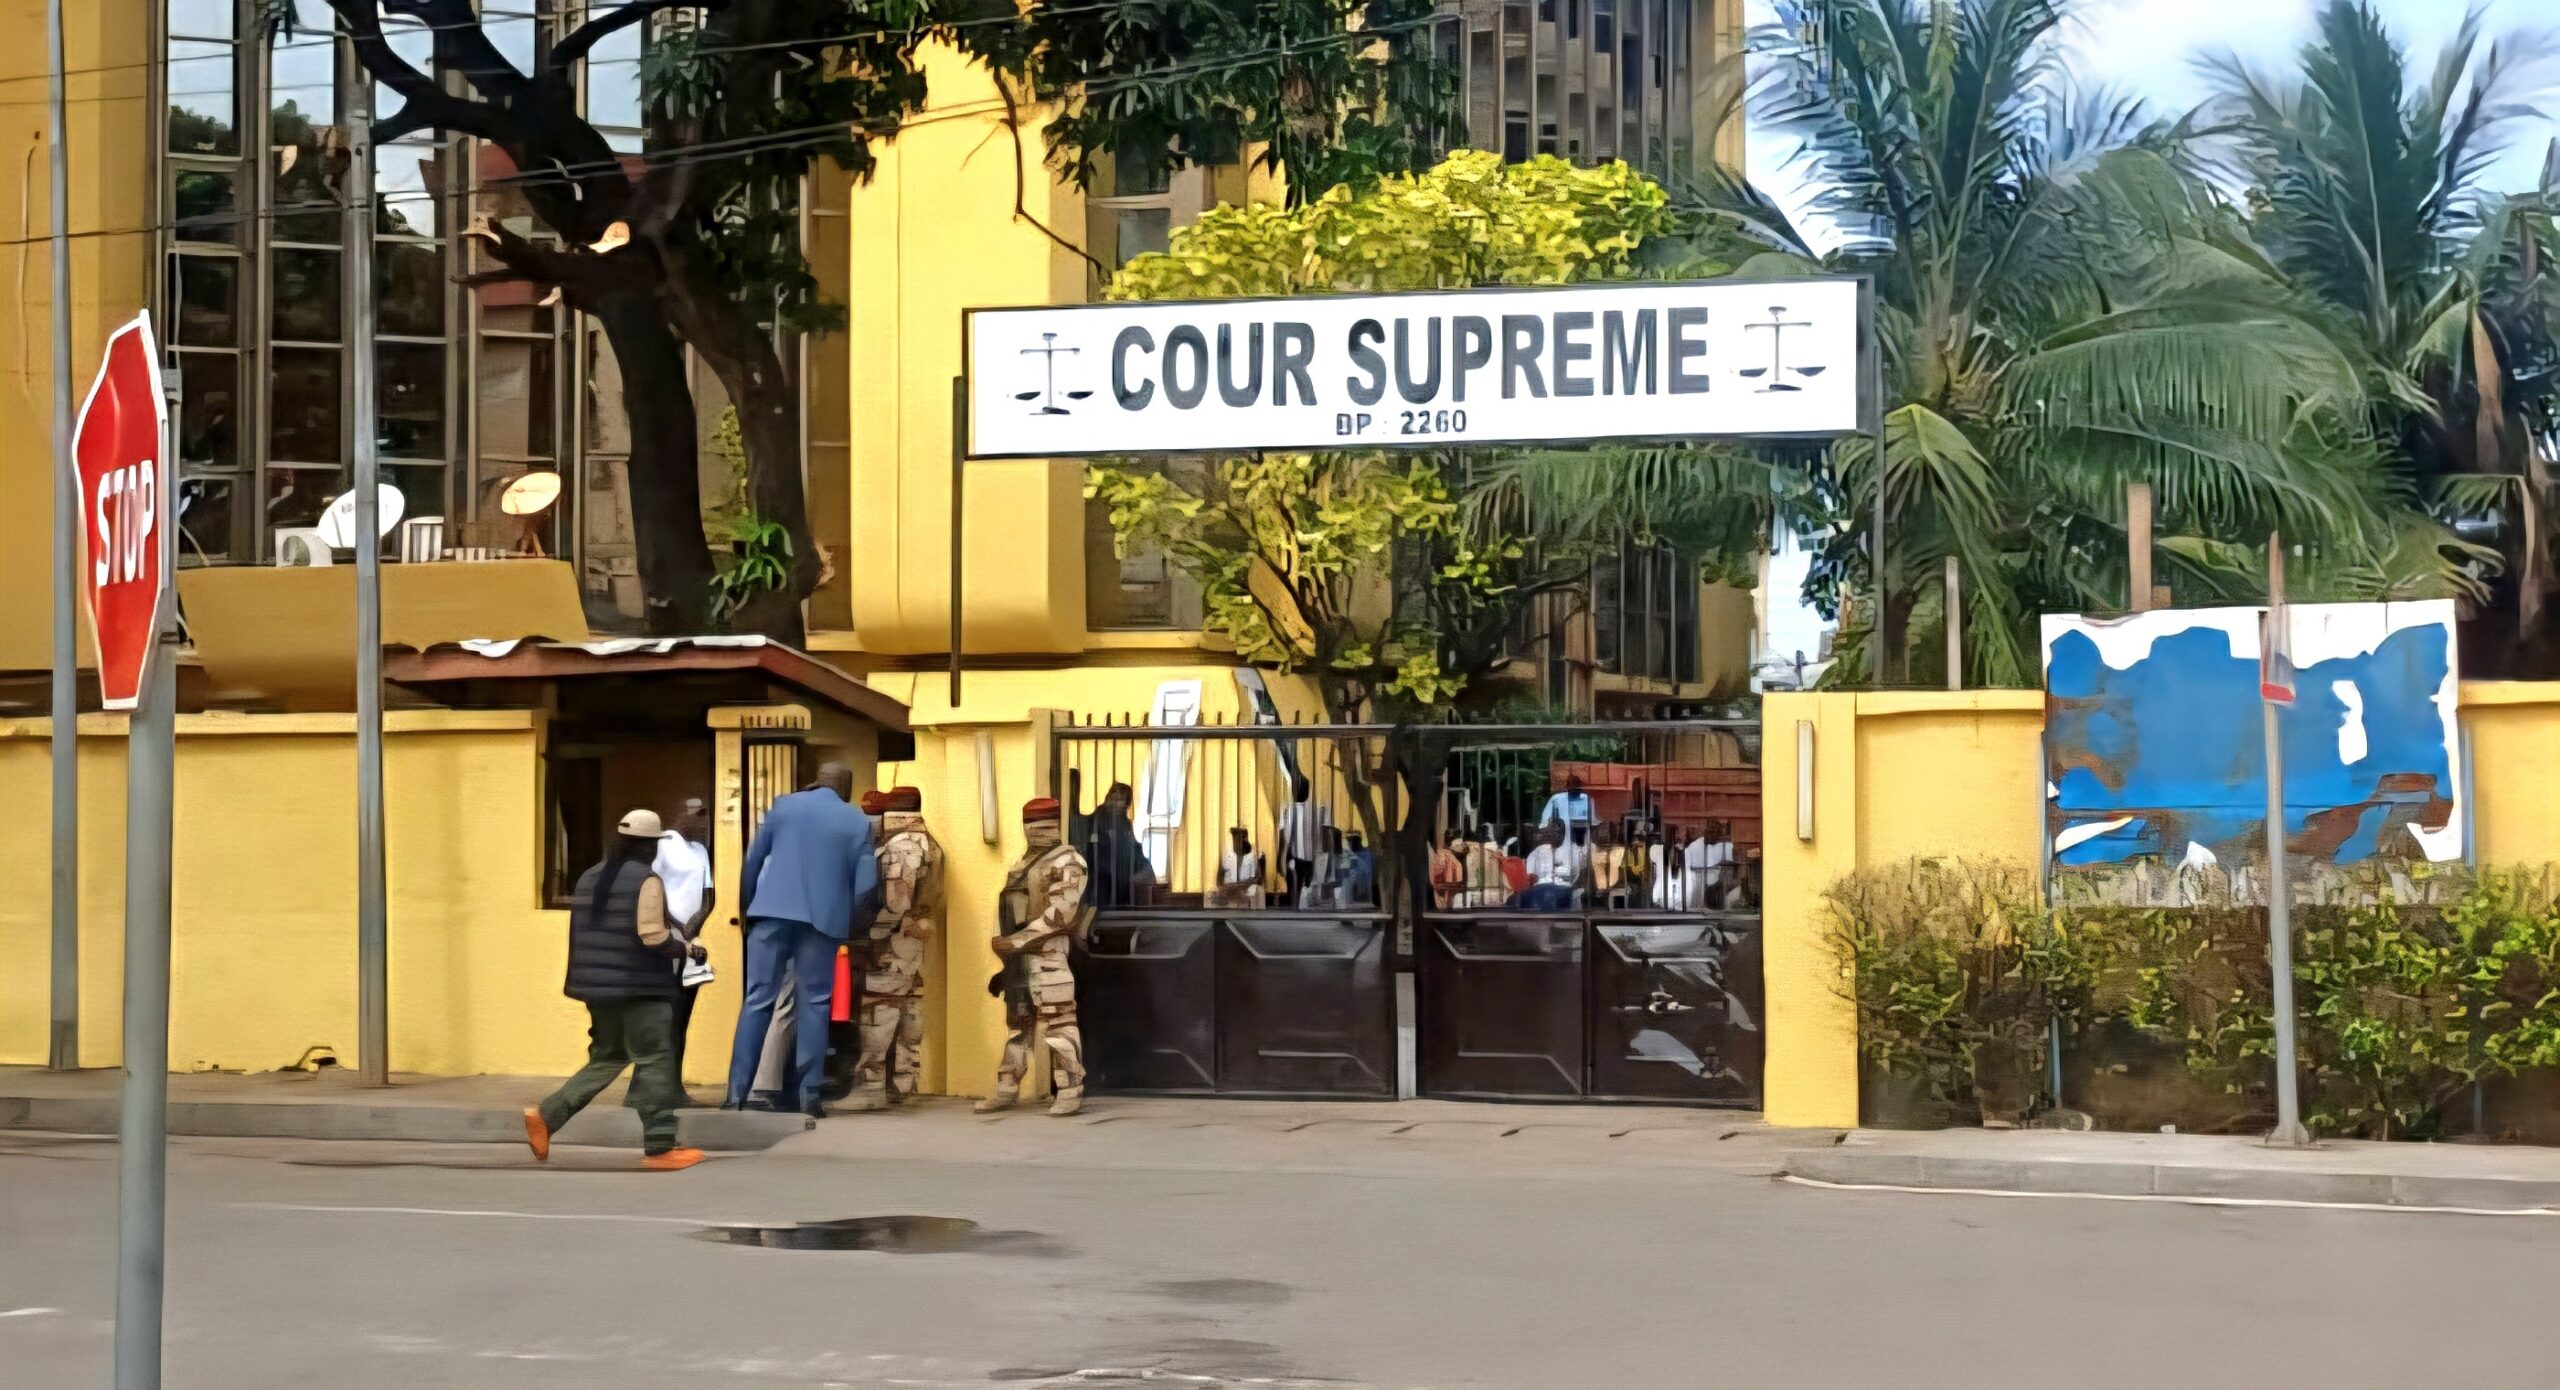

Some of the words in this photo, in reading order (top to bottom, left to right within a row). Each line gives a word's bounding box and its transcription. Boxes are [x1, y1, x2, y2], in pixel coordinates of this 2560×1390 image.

[1111, 321, 1318, 411] COUR
[1346, 307, 1710, 406] SUPREME
[1400, 409, 1467, 435] 2260
[95, 459, 155, 587] STOP
